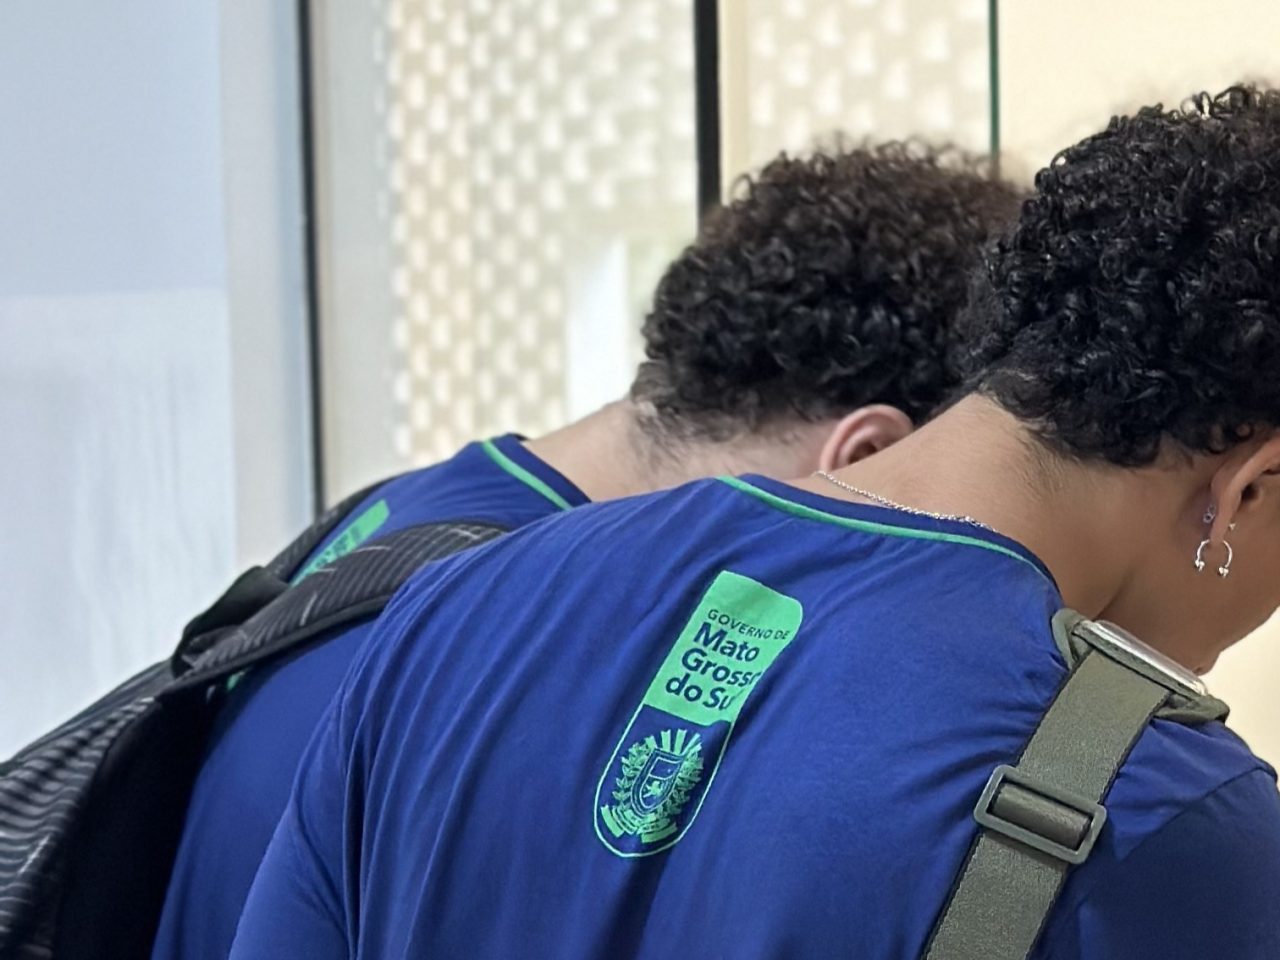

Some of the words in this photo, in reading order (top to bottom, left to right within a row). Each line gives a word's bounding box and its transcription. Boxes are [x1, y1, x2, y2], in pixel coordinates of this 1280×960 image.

[693, 621, 760, 662] Mato
[708, 609, 773, 639] GOVERNO
[774, 629, 791, 640] DE
[665, 673, 703, 702] do
[702, 687, 738, 711] Su
